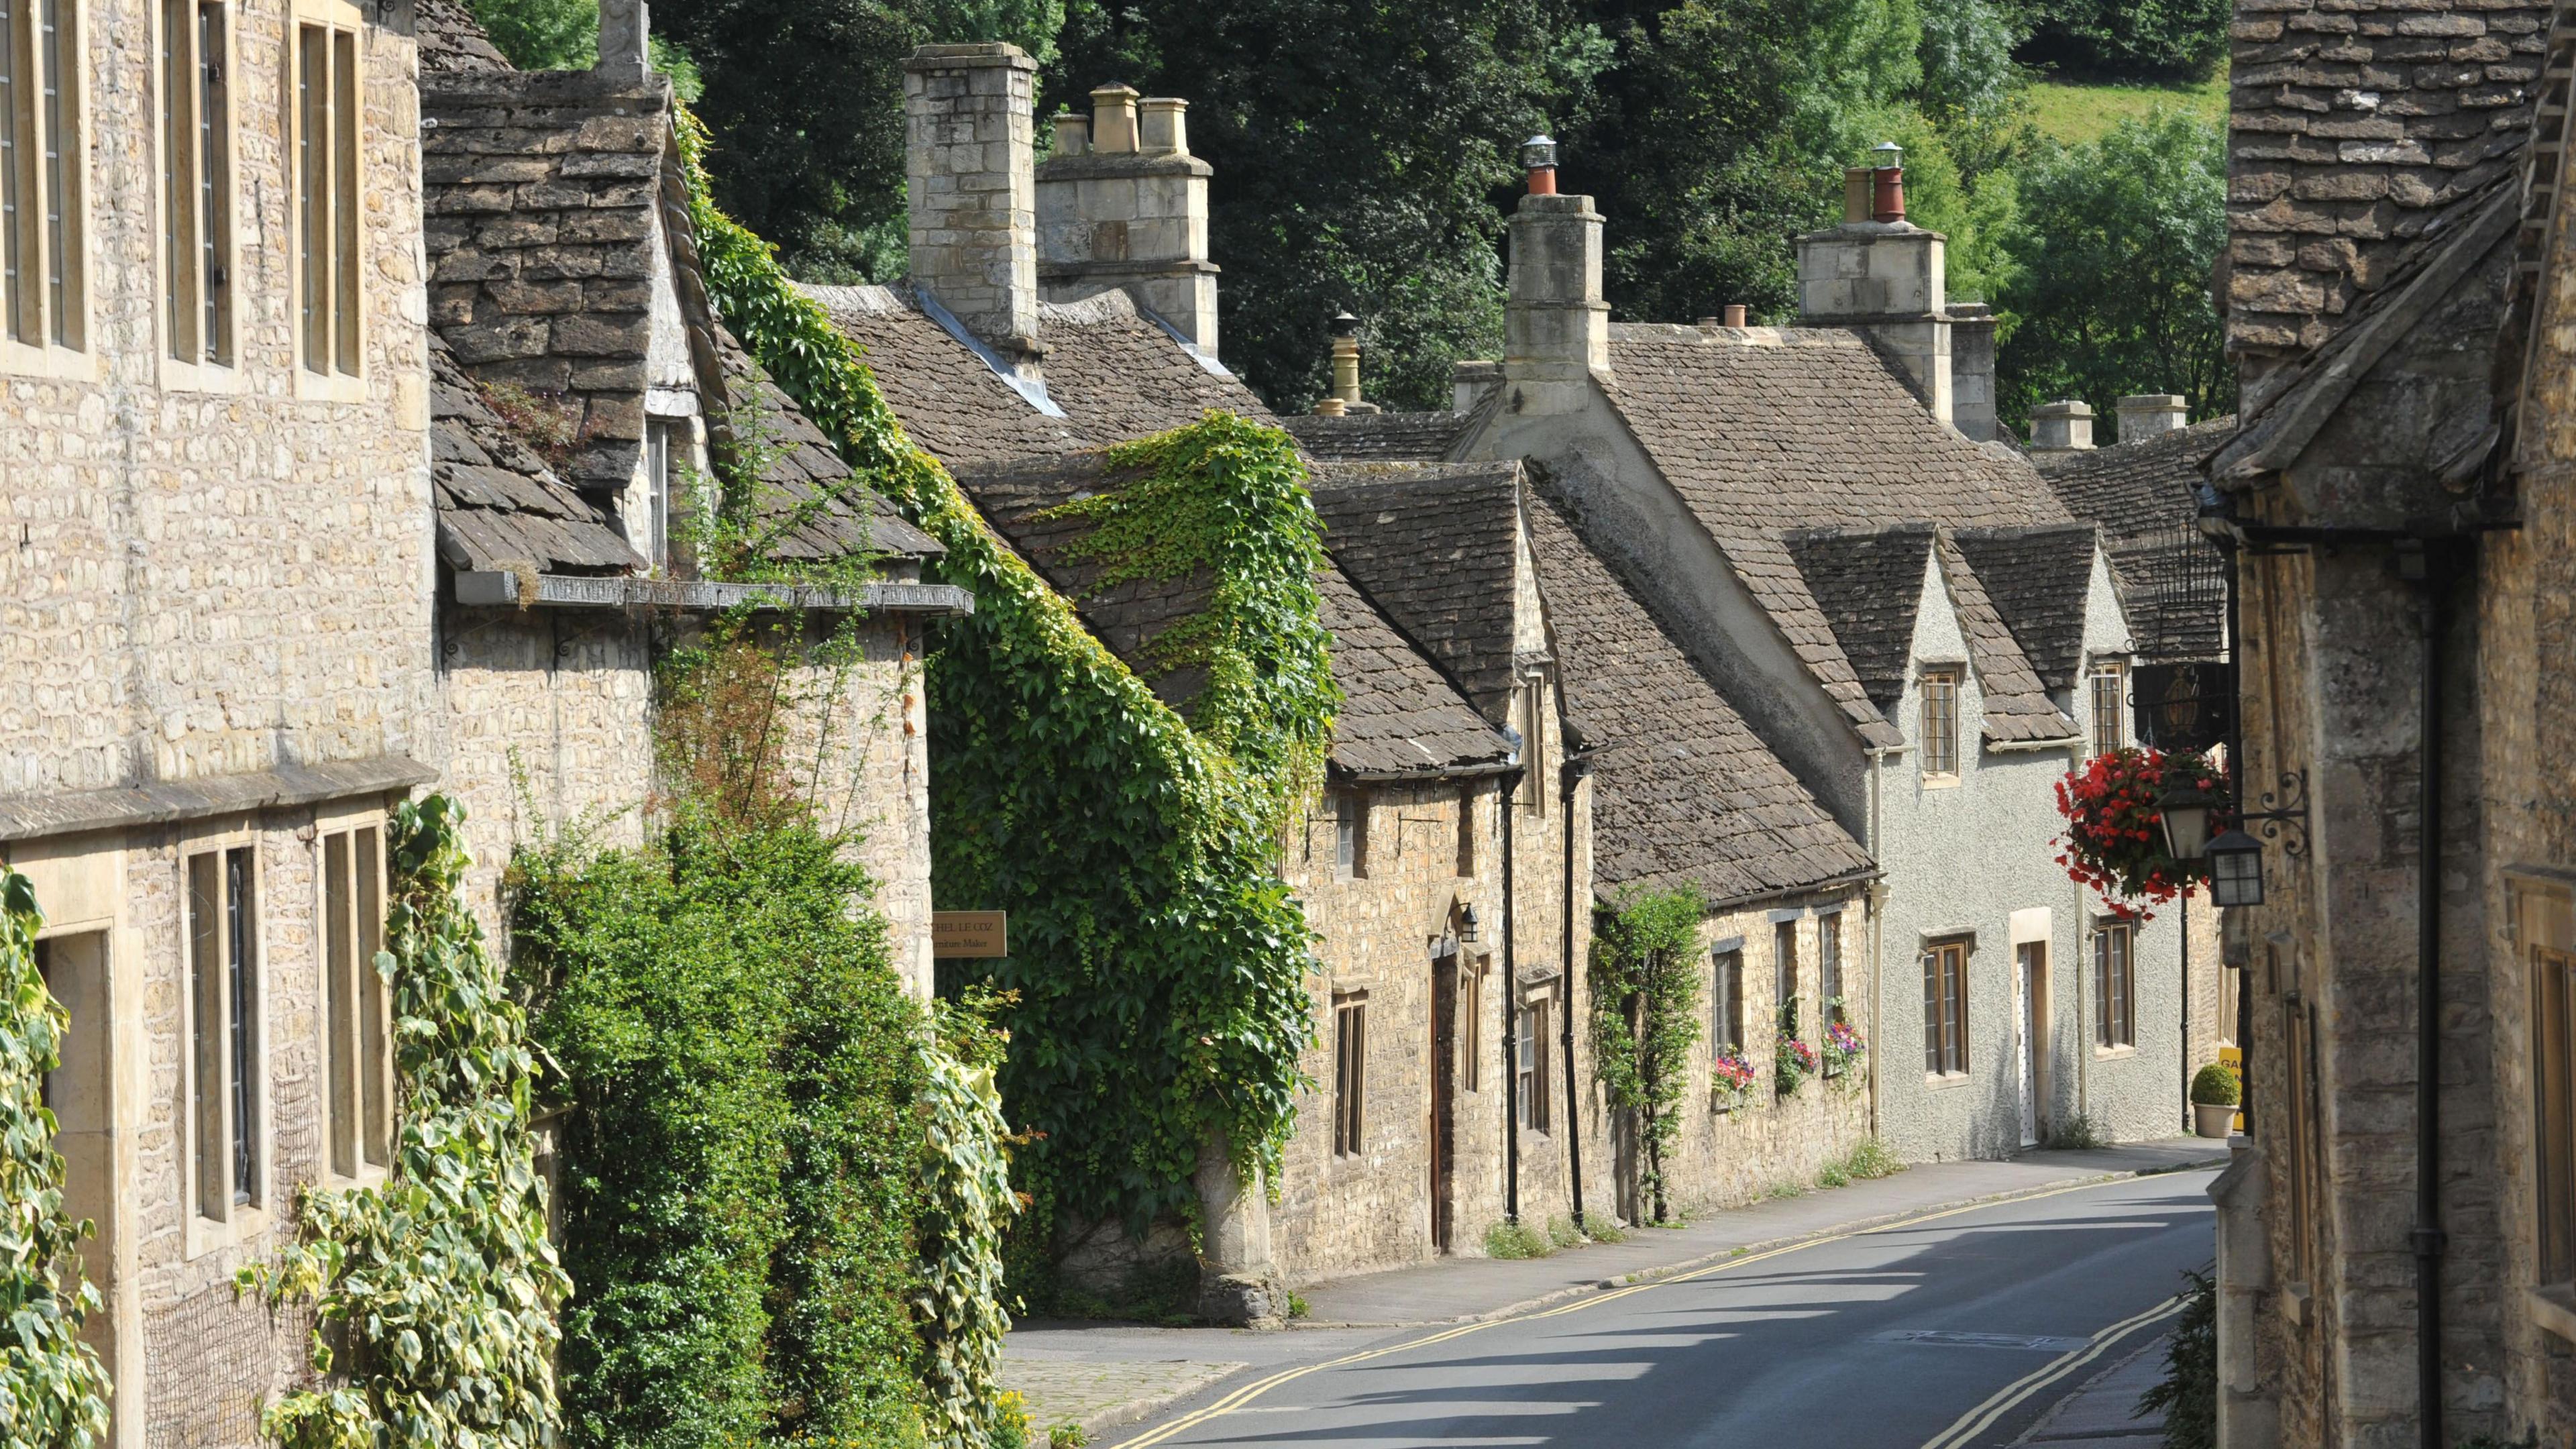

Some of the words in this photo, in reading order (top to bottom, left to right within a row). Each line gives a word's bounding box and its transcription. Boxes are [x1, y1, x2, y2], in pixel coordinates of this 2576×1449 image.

[959, 922, 971, 932] LE
[973, 922, 993, 932] COZ
[963, 939, 987, 947] Maker
[2221, 1059, 2242, 1069] GA
